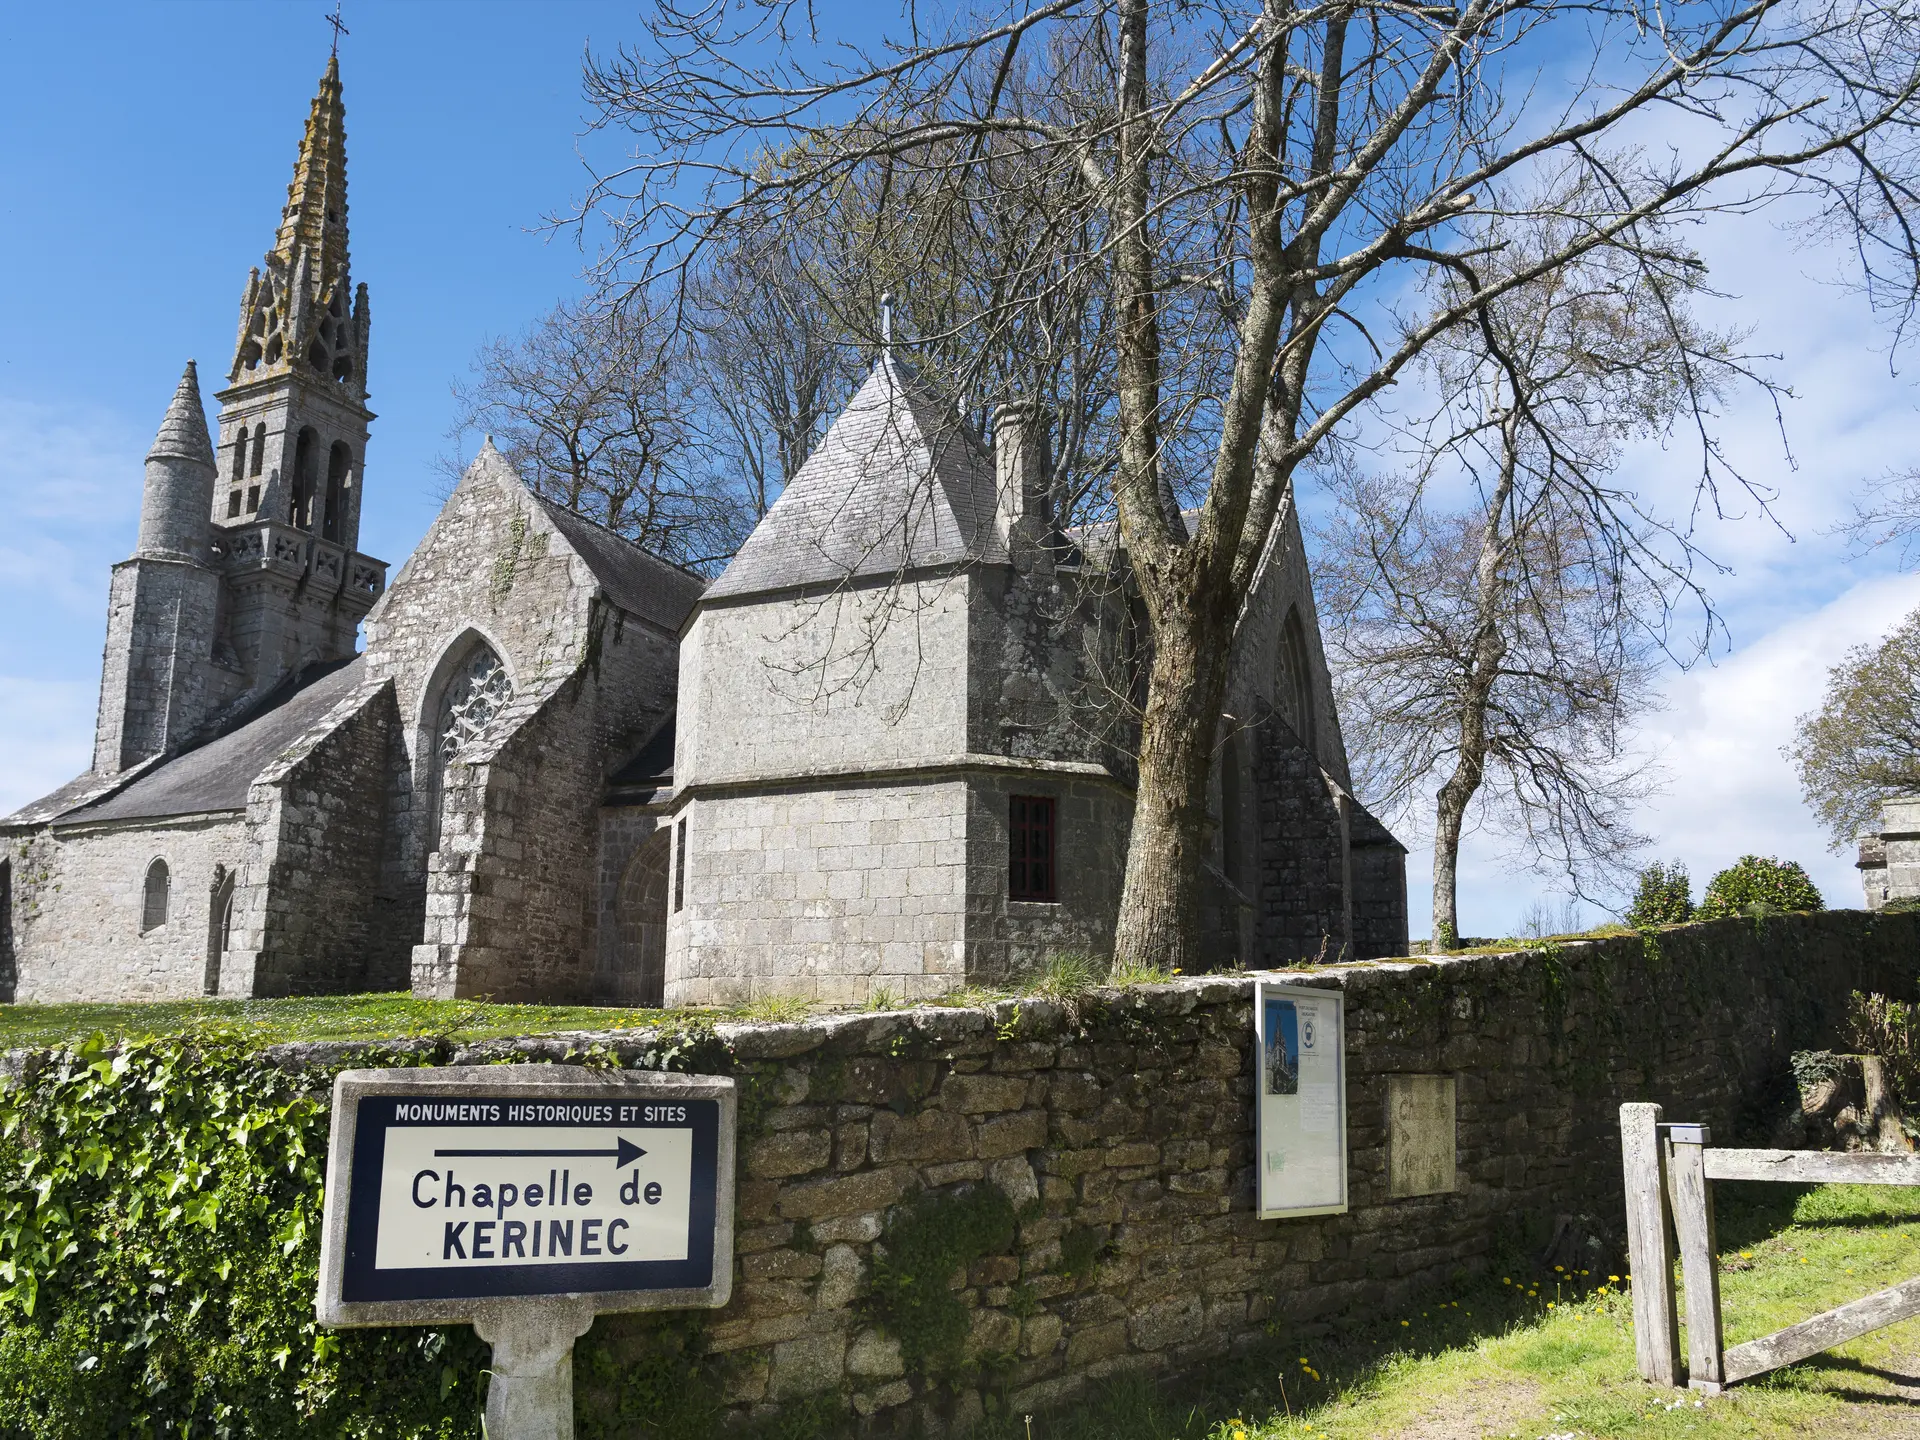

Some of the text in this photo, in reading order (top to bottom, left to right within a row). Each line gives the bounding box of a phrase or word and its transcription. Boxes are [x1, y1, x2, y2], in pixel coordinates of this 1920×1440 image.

[395, 1104, 687, 1122] MONUMENTS HISTORIQUES ET SITES
[412, 1168, 663, 1221] Chapelle de
[442, 1218, 630, 1260] KERINEC
